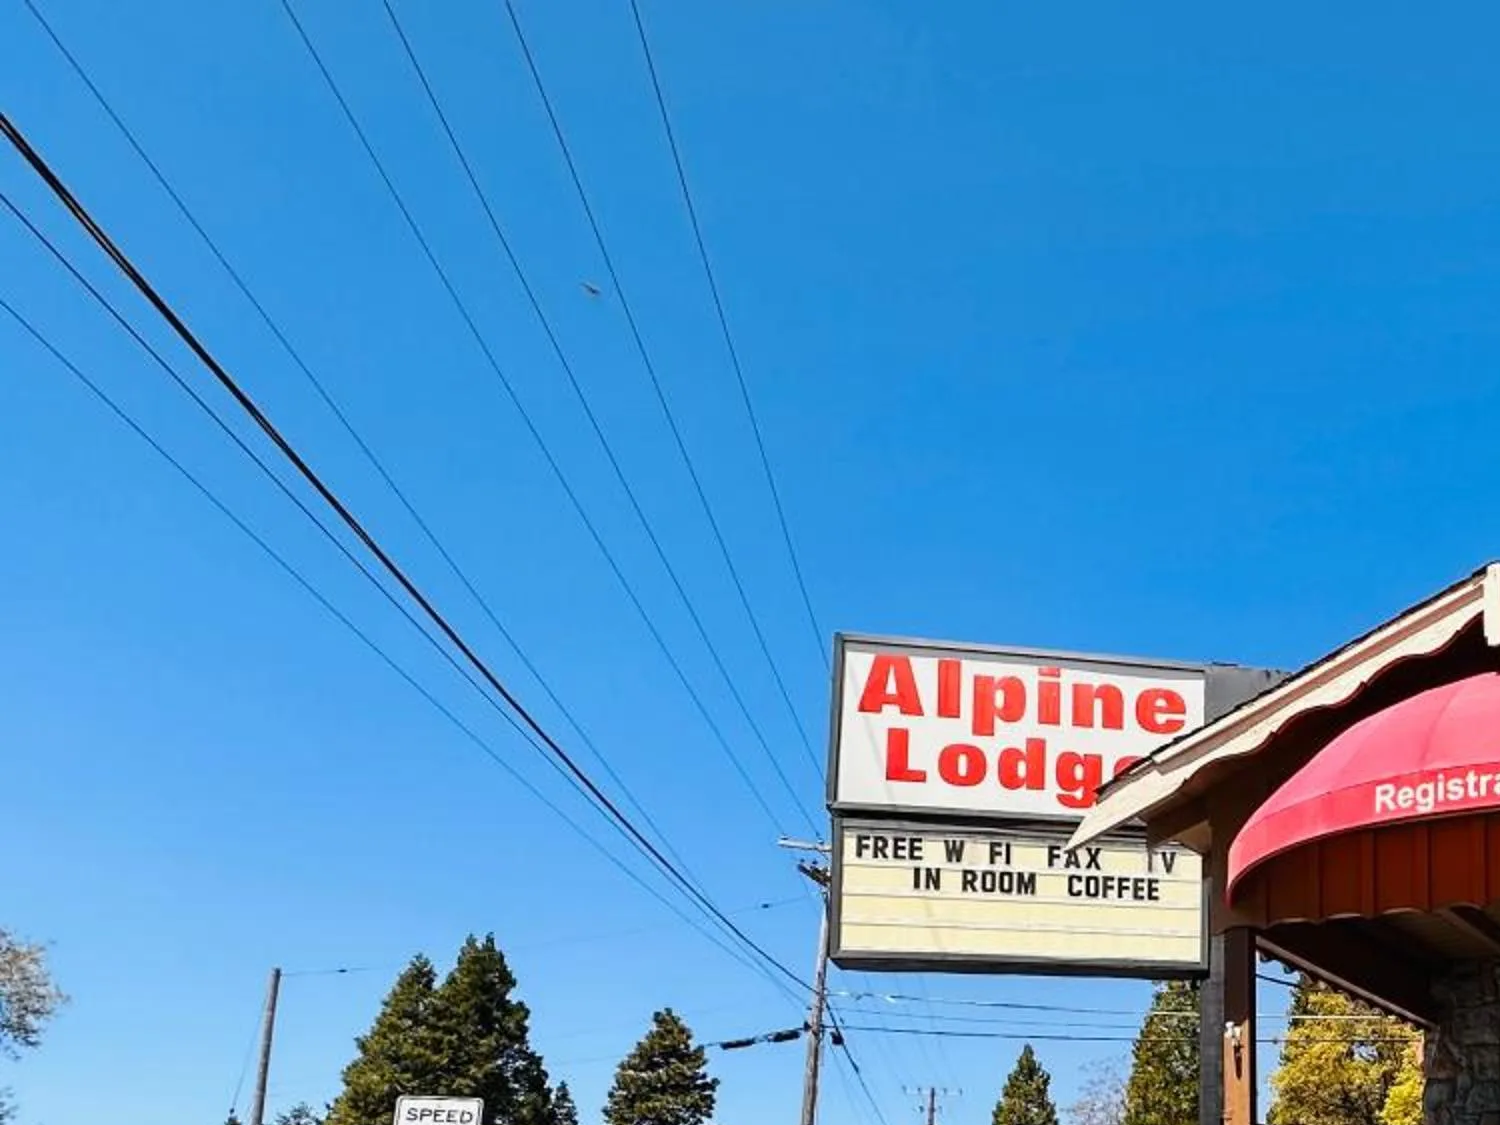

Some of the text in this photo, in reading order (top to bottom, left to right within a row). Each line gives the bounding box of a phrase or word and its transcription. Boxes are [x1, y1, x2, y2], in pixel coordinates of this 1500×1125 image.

[857, 653, 1187, 735] Alpine
[855, 834, 923, 861] FREE
[989, 841, 1011, 865] FI
[1047, 845, 1102, 871] FAX
[913, 867, 1160, 901] IN ROOM COFFEE
[405, 1107, 474, 1125] SPEED
